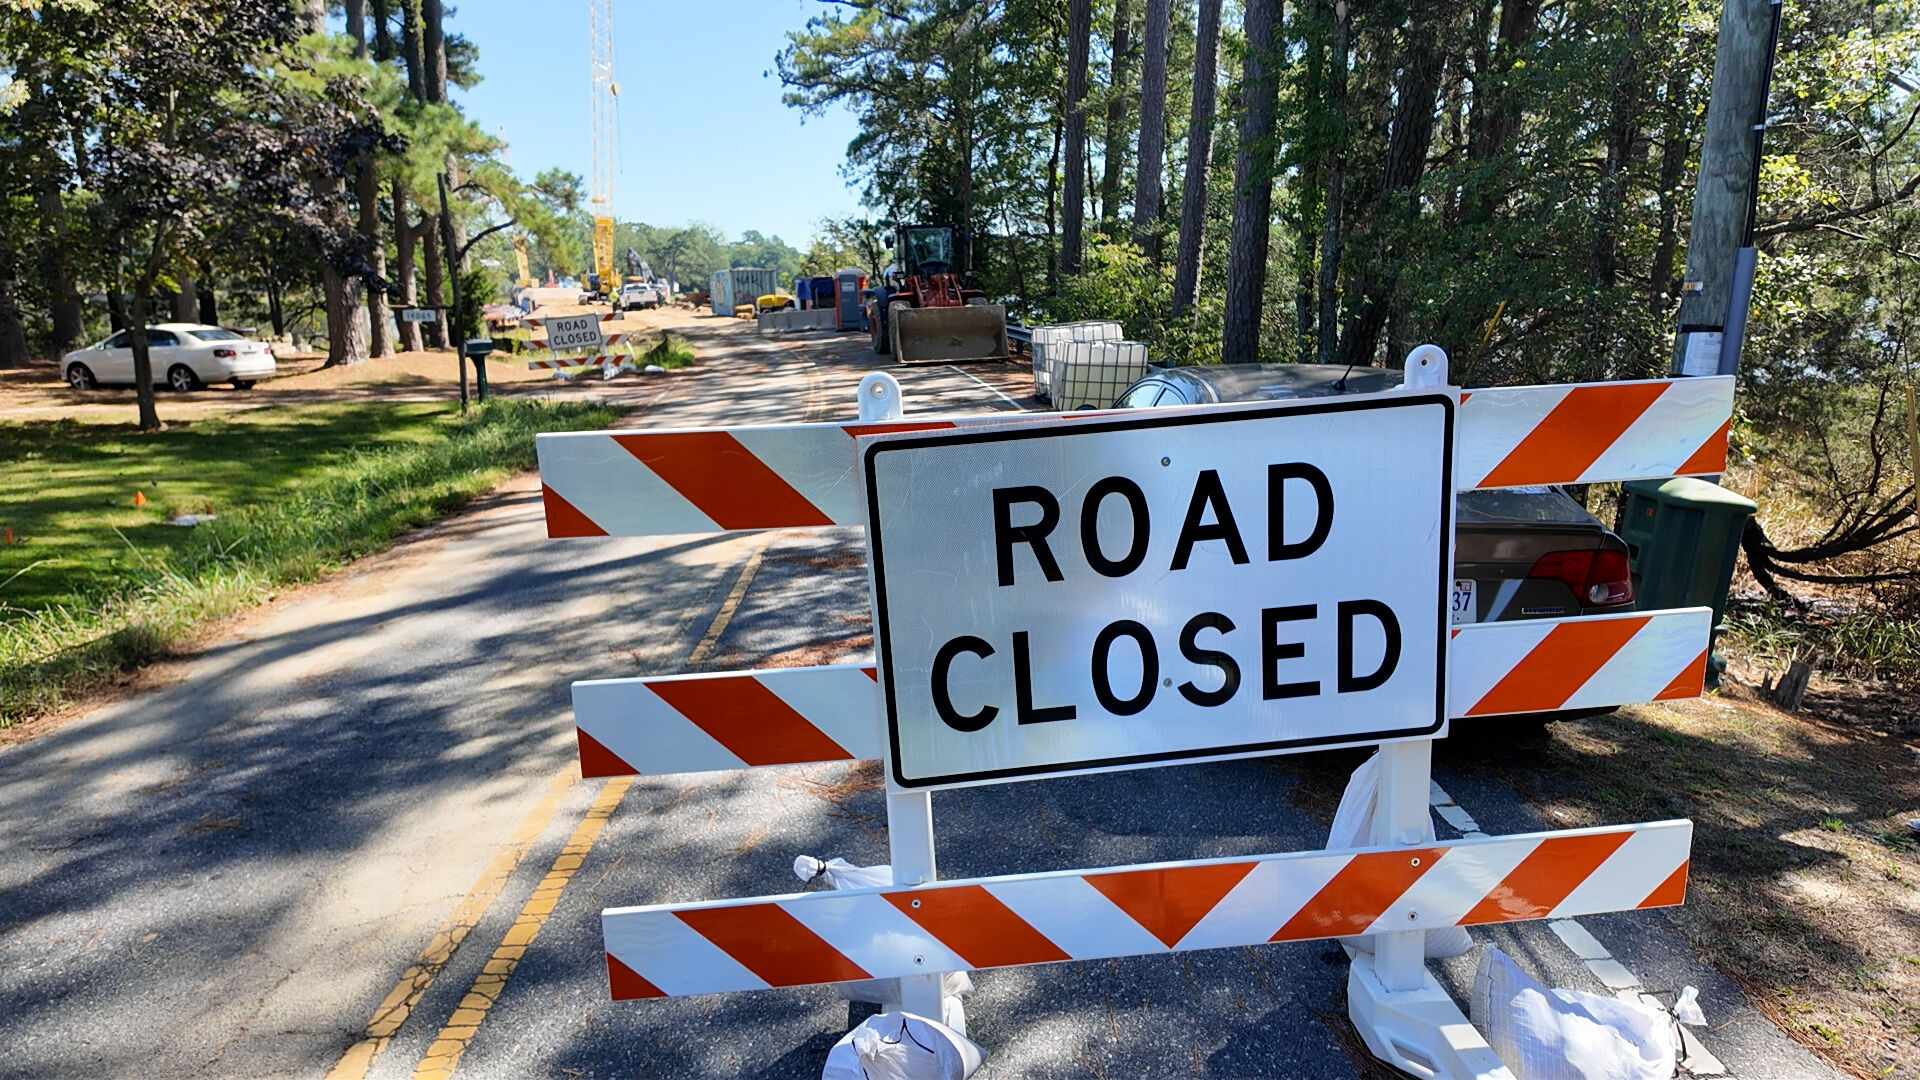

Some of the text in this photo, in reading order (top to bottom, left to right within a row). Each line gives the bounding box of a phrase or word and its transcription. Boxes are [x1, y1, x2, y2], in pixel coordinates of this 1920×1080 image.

[553, 331, 597, 346] CLOSED
[557, 319, 588, 332] ROAD
[992, 461, 1335, 587] ROAD
[931, 599, 1402, 732] CLOSED
